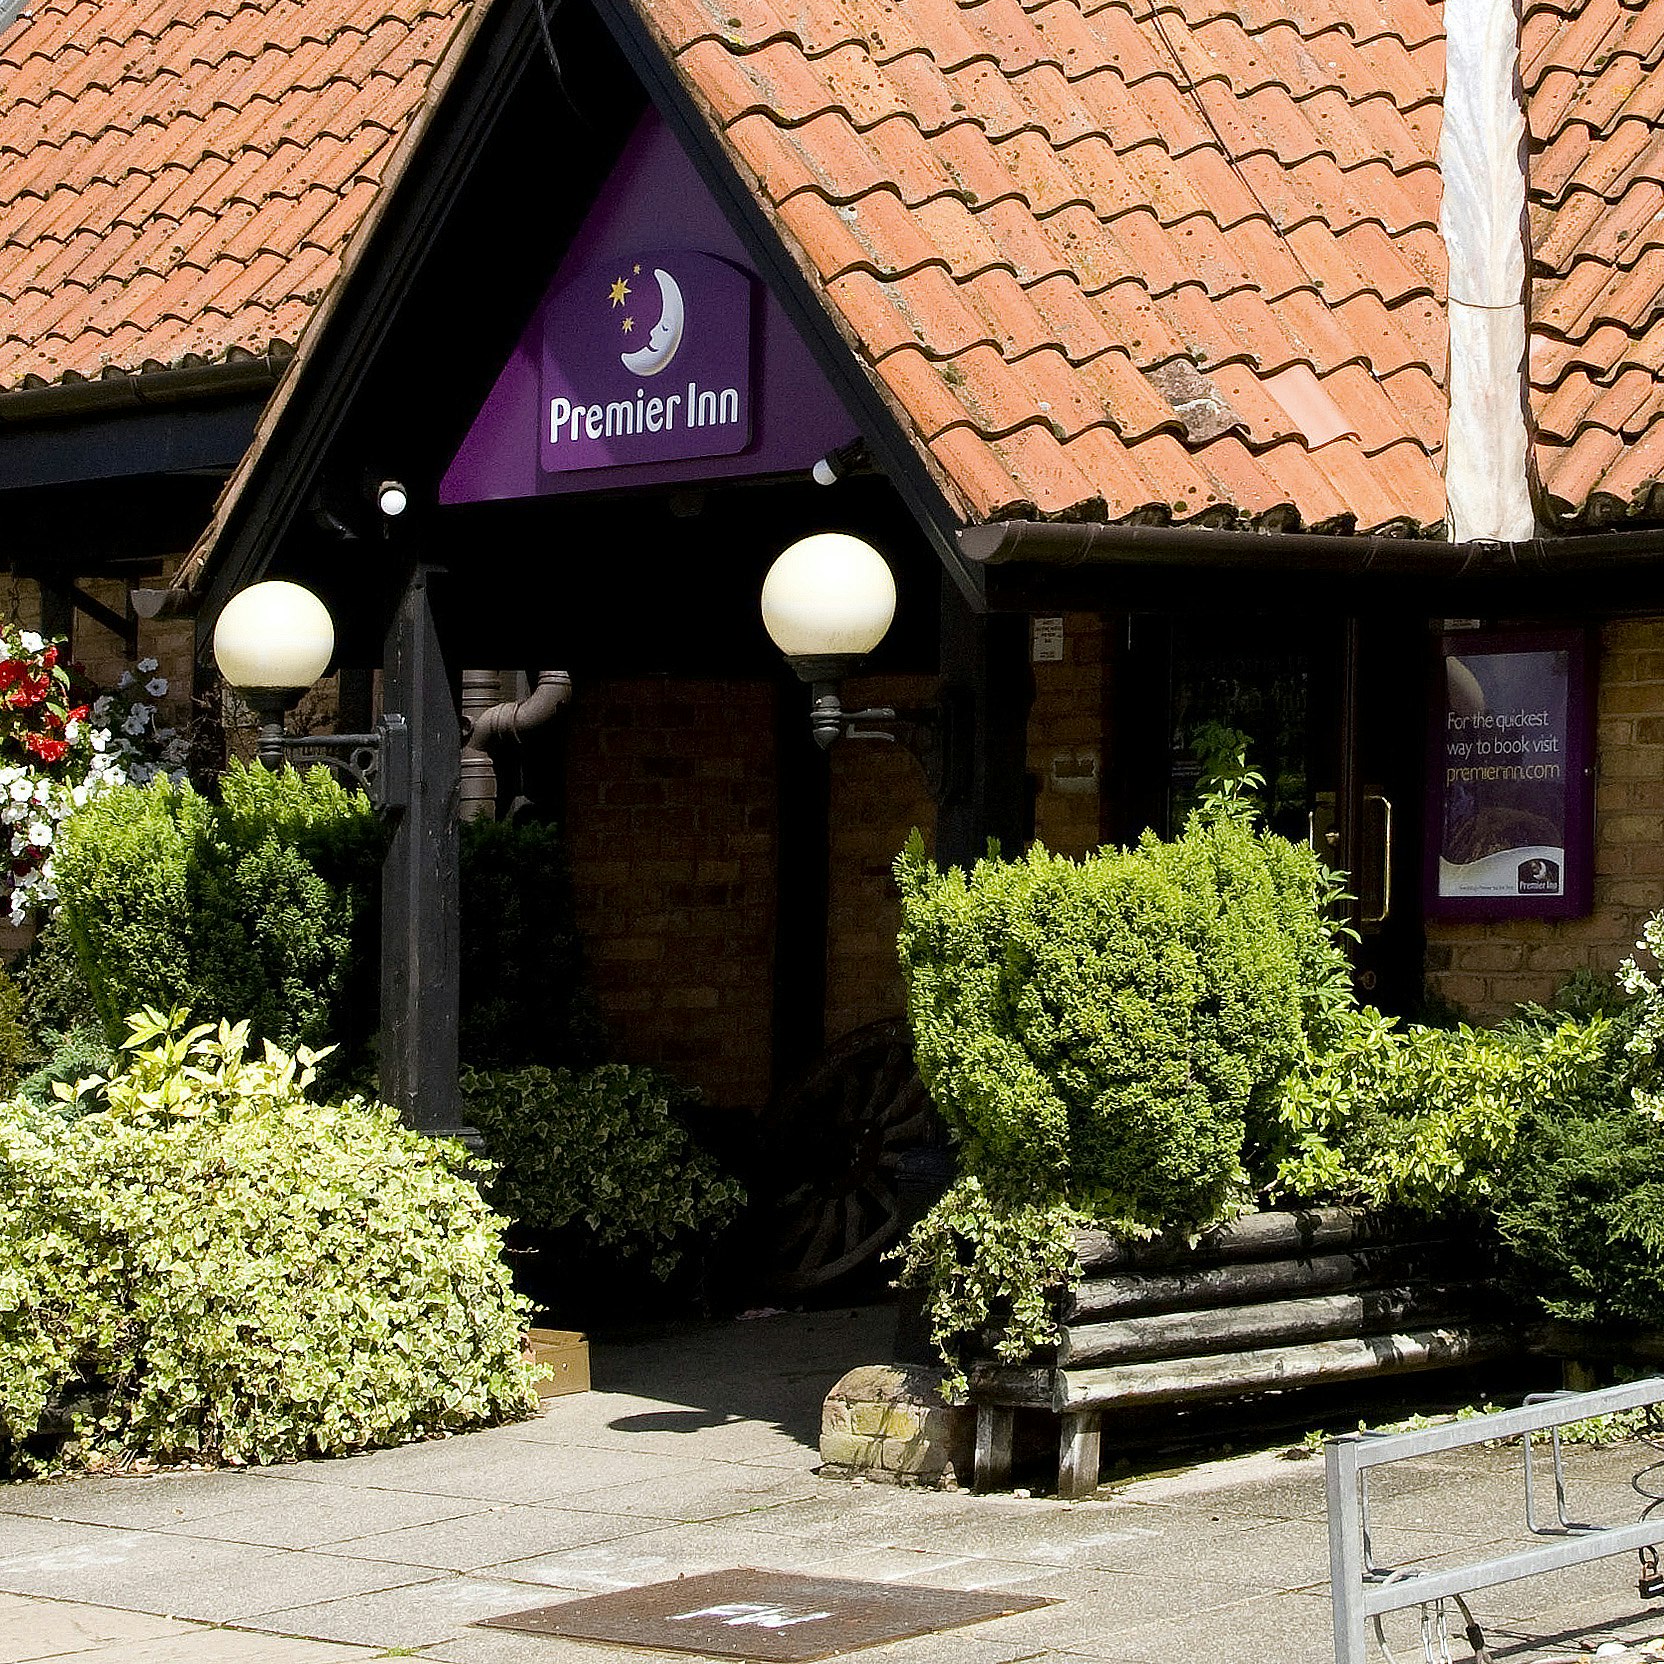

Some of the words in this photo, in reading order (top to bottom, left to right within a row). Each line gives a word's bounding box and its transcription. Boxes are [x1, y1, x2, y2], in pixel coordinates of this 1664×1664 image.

[549, 387, 681, 444] Premier
[686, 382, 738, 428] Inn
[1447, 711, 1469, 730] For
[1473, 711, 1494, 729] the
[1496, 709, 1549, 733] quickest
[1447, 741, 1473, 760] way
[1476, 738, 1491, 755] to
[1494, 736, 1530, 754] book
[1532, 734, 1559, 753] visit
[1447, 763, 1560, 788] premierinn.com
[1519, 881, 1546, 891] Premier
